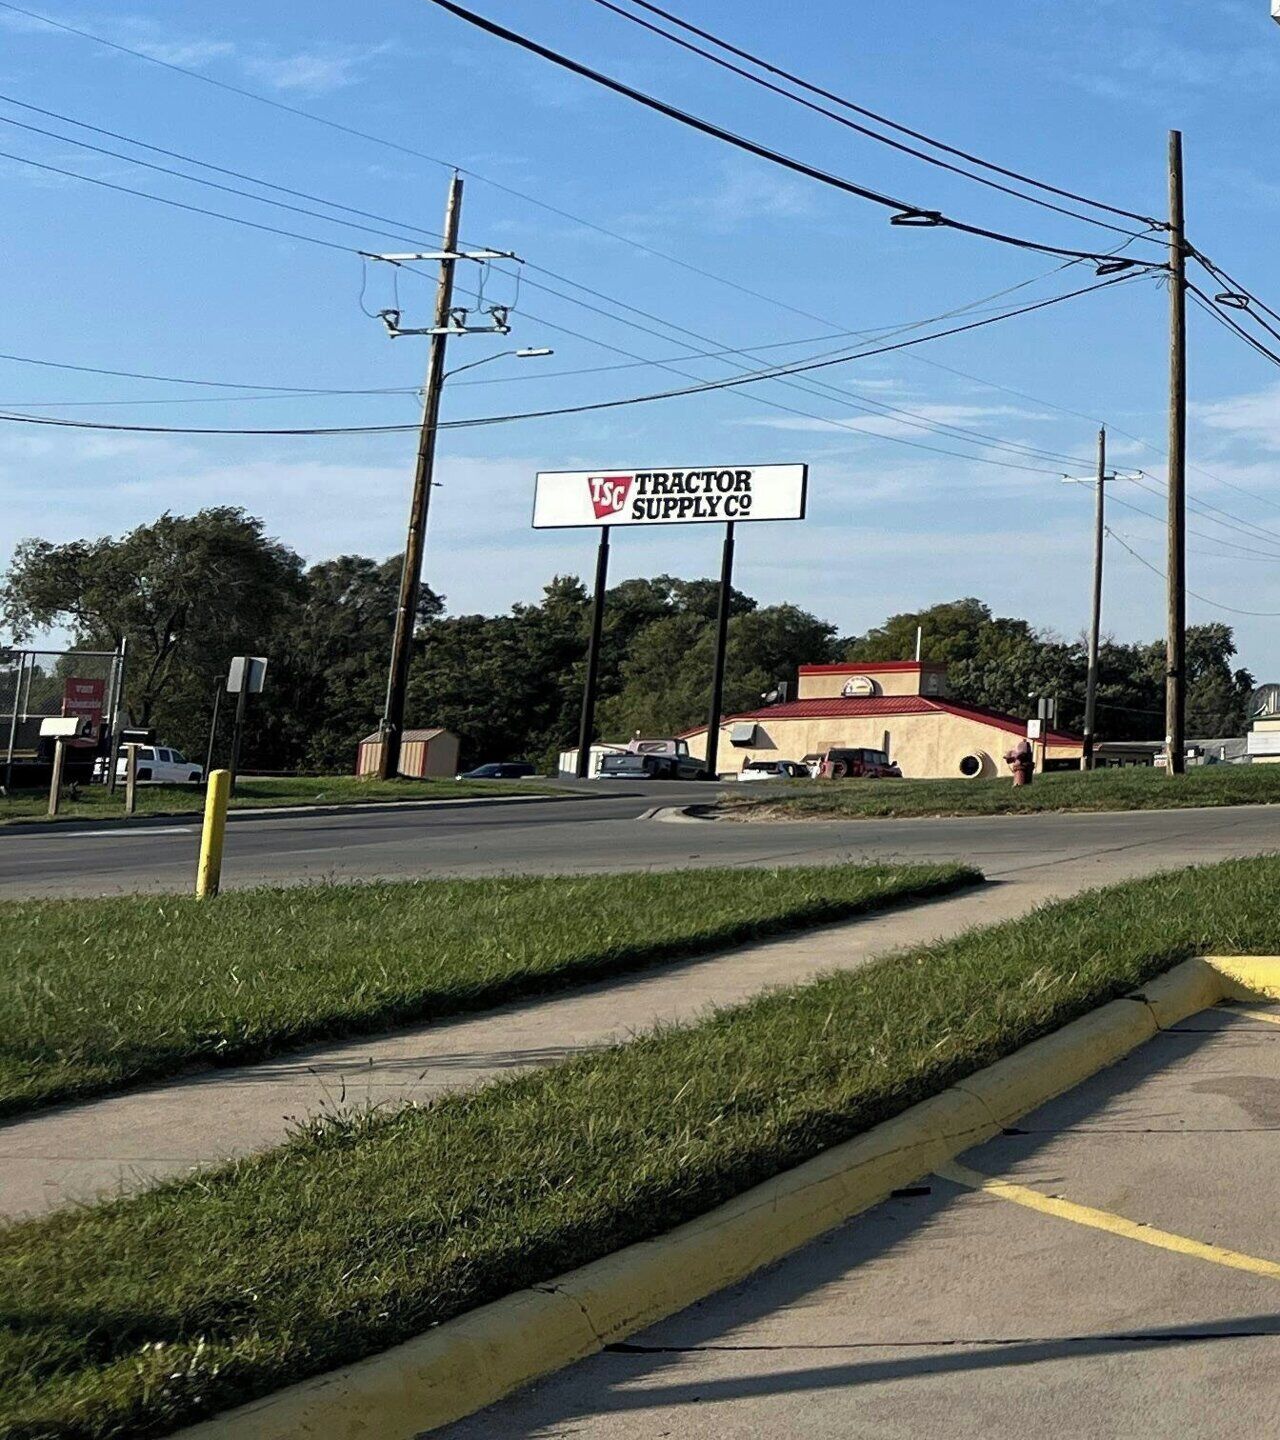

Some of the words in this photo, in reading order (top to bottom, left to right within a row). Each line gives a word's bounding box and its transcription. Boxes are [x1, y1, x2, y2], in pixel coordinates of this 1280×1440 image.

[591, 477, 625, 511] TSC
[634, 470, 753, 495] TRACTOR
[631, 496, 723, 520] SUPPLY
